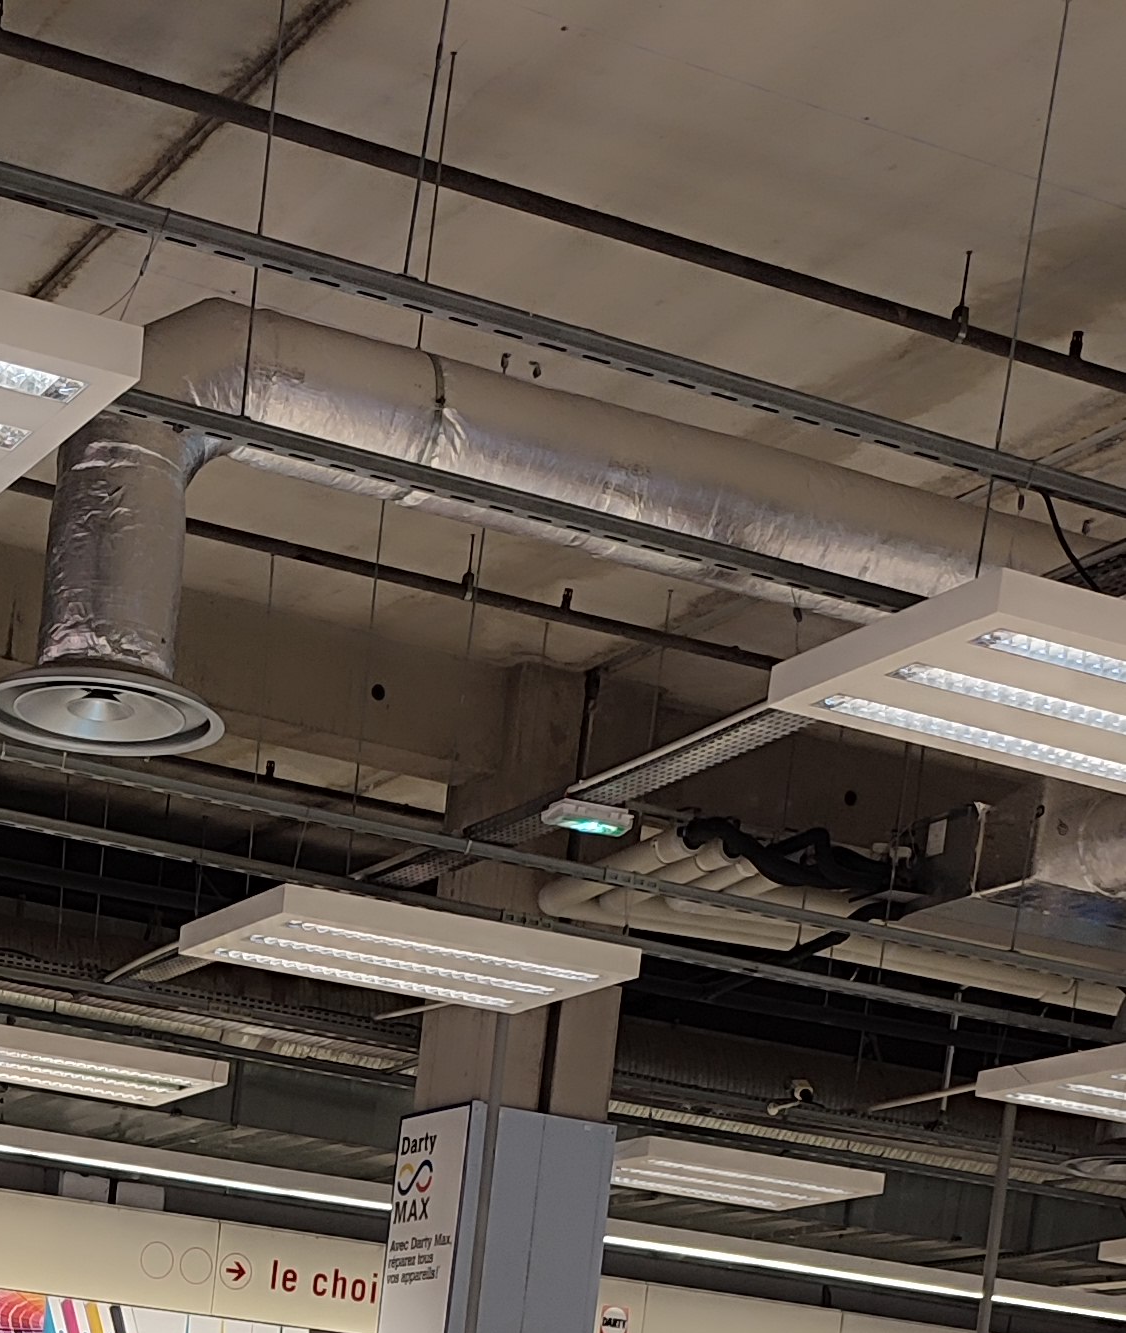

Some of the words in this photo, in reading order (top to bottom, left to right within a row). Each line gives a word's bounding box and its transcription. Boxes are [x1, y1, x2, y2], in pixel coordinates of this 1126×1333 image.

[400, 1132, 437, 1156] Darty
[393, 1196, 430, 1224] MAX
[411, 1236, 433, 1250] Darty
[270, 1259, 298, 1293] le
